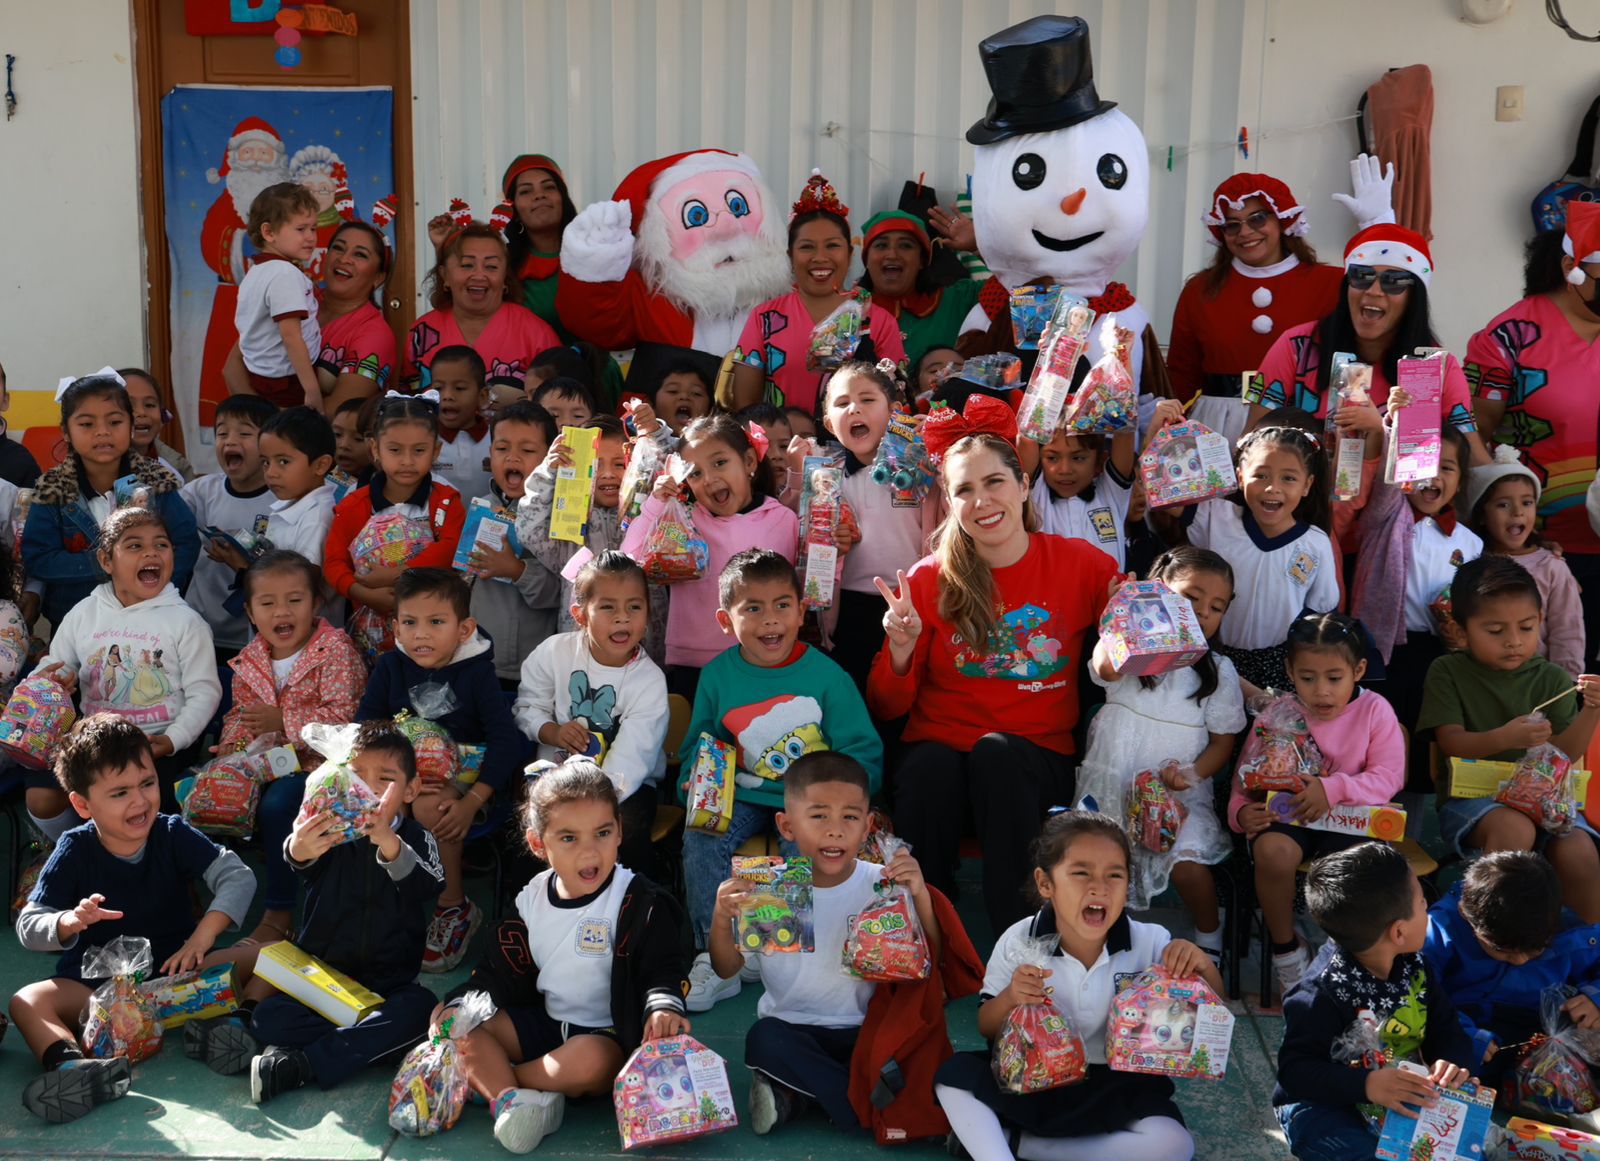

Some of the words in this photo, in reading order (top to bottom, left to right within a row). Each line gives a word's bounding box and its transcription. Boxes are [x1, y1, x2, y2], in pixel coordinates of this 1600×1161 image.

[890, 424, 915, 442] TRUCKS
[93, 627, 121, 640] we're
[122, 626, 148, 640] kind
[150, 633, 161, 647] of
[741, 873, 769, 883] TRUCKS
